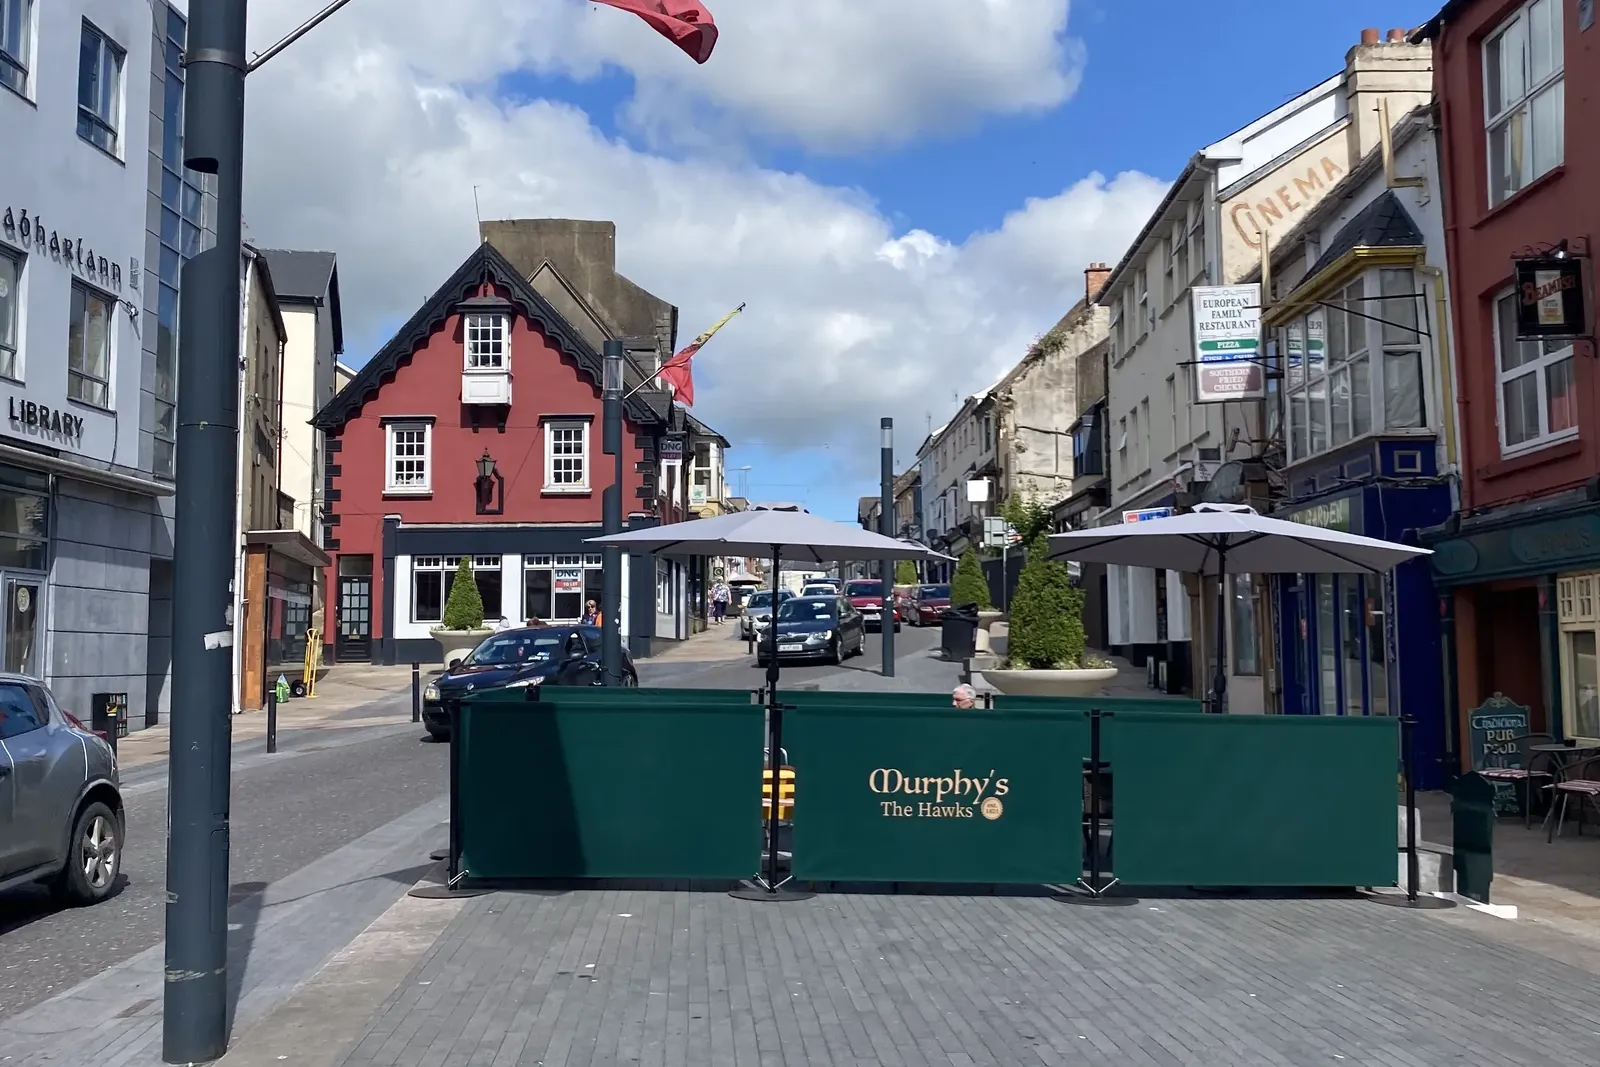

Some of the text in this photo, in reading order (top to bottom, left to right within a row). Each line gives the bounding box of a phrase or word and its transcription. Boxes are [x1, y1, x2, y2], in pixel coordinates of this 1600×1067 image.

[1231, 156, 1343, 249] CINEMA
[1203, 297, 1249, 308] EUROPEAN
[1211, 309, 1243, 319] FAMILY
[1199, 320, 1257, 331] RESTAURANT
[1217, 341, 1240, 349] PIZZA
[1209, 368, 1251, 377] SOUTHERN
[1219, 376, 1243, 384] FRIED
[1213, 383, 1249, 391] CHICKEN
[9, 396, 83, 438] LIBRARY
[1305, 500, 1343, 527] GARDEN
[1486, 729, 1514, 742] PUB
[869, 768, 1010, 805] Murphy's
[880, 800, 973, 818] The Hawks
